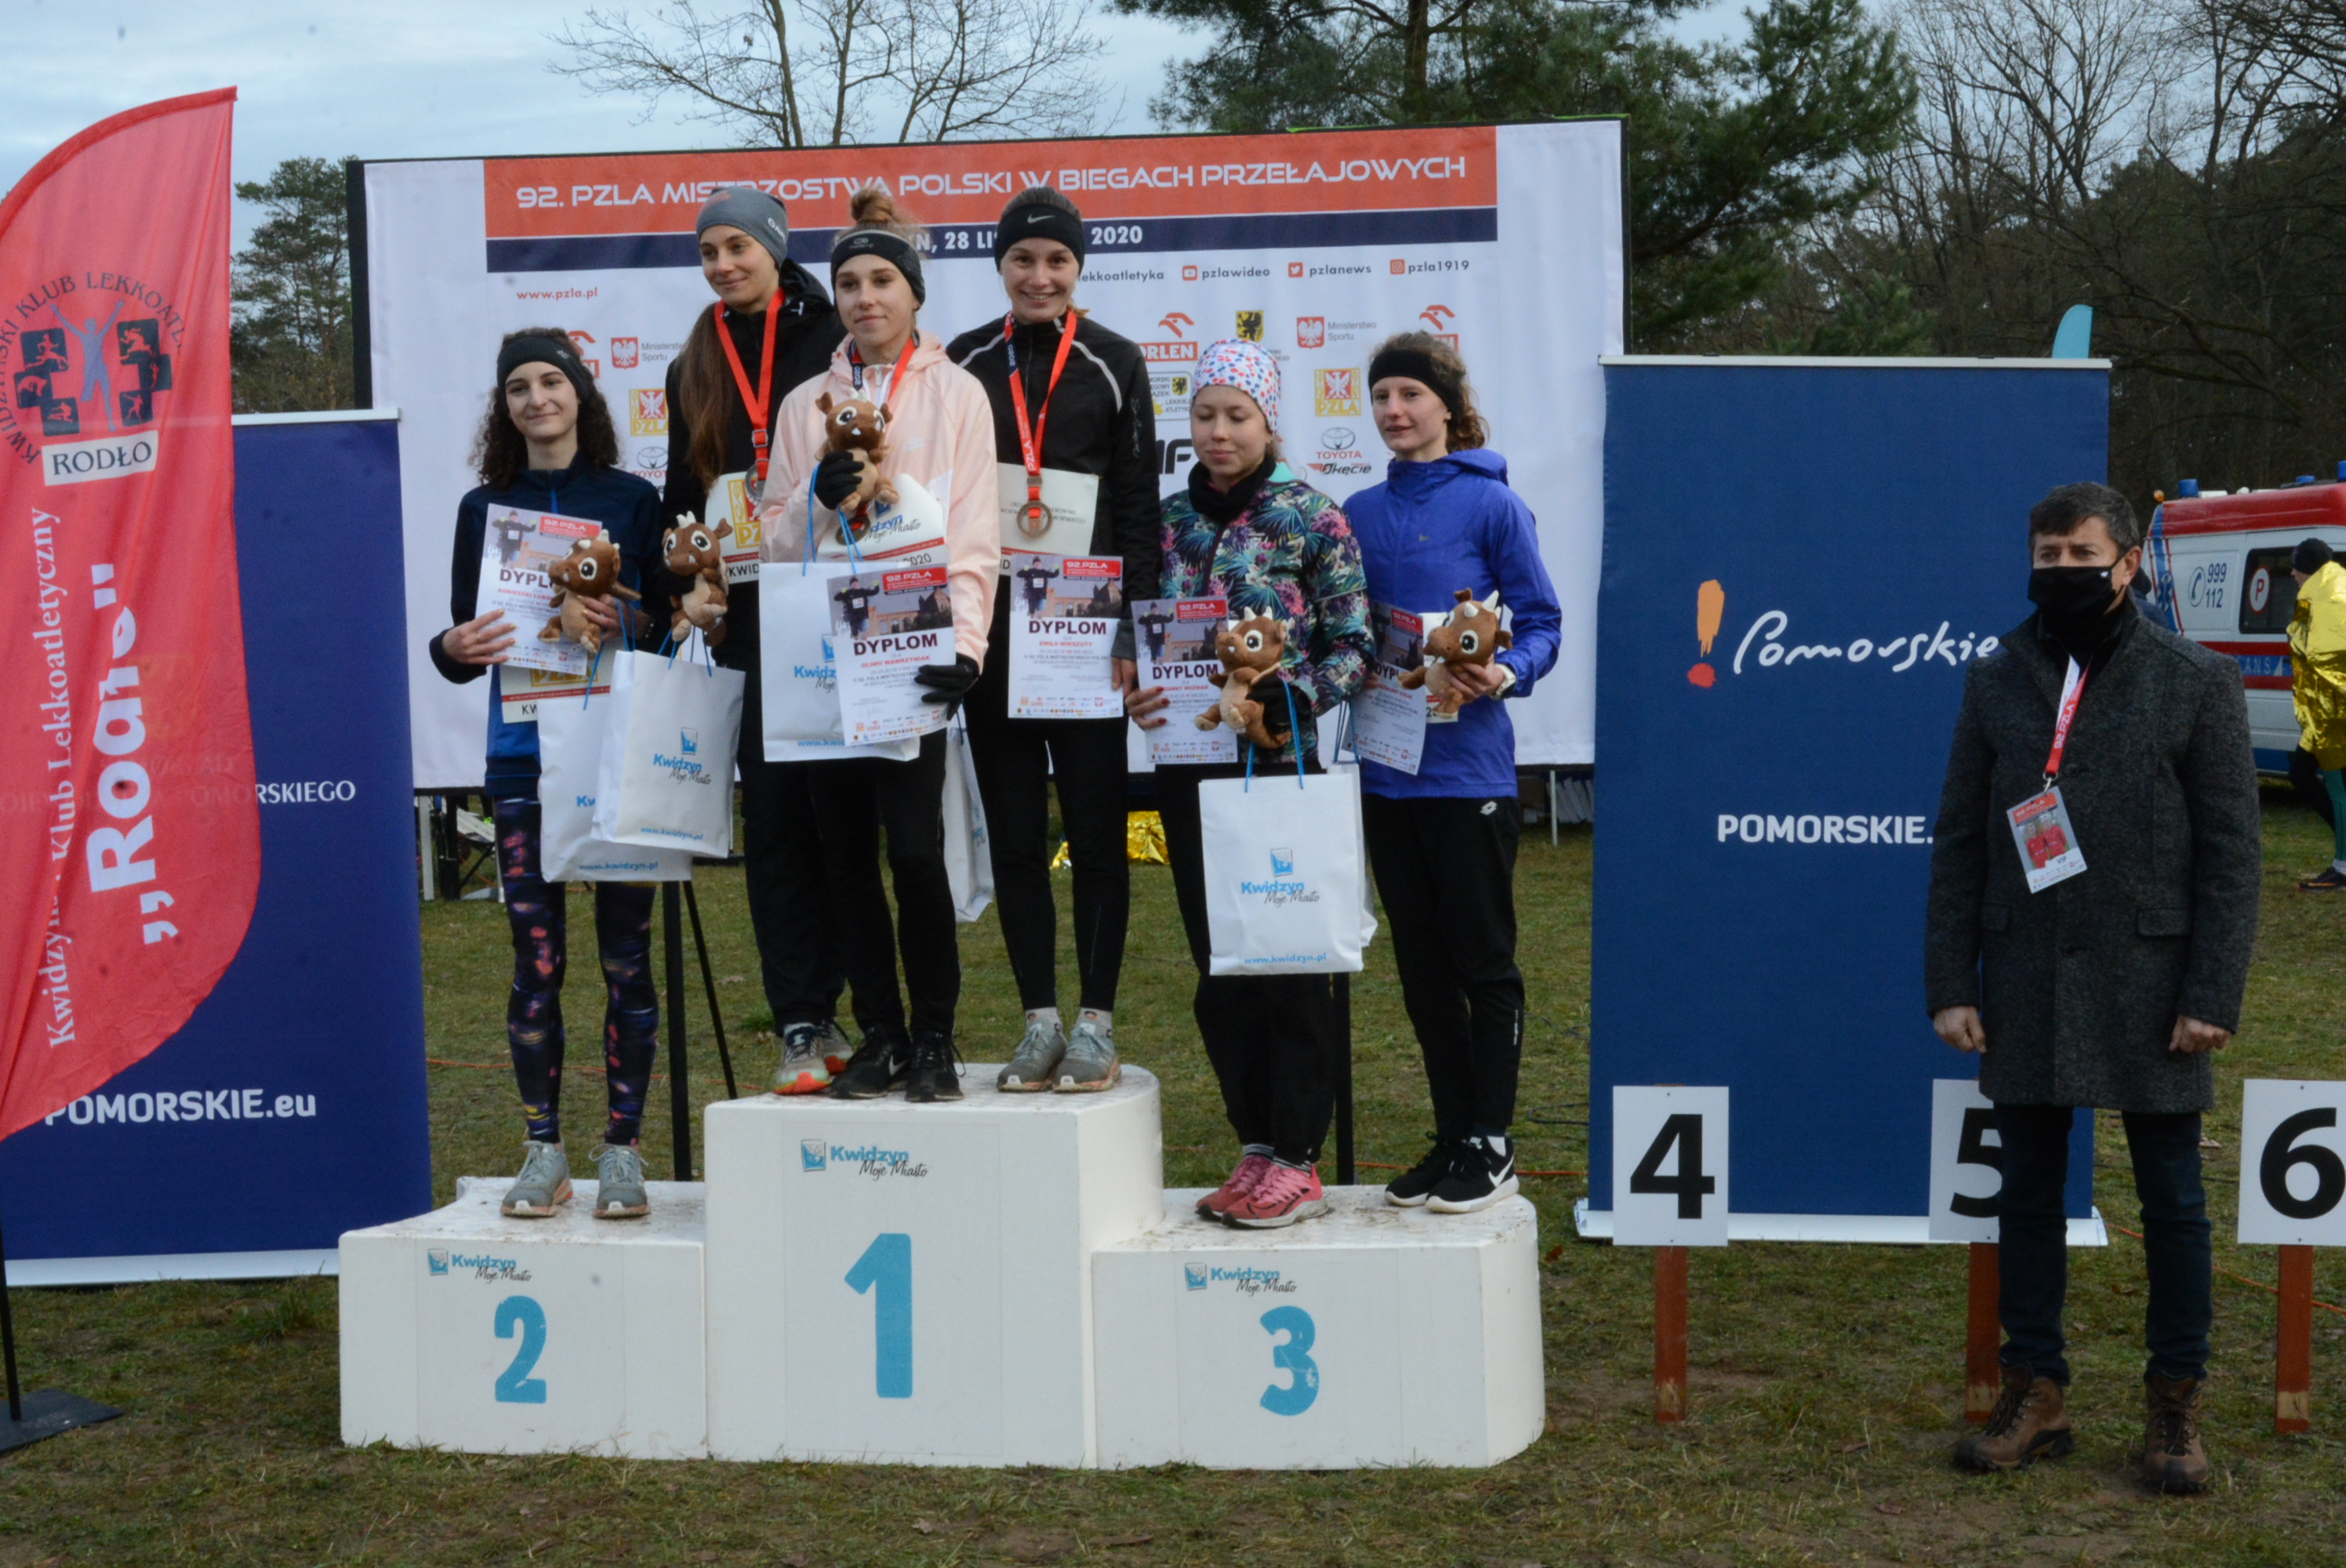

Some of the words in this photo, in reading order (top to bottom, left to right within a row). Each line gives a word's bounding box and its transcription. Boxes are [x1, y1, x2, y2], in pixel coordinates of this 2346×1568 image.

[516, 186, 565, 209] 92.
[572, 183, 656, 207] PZLA
[899, 171, 1012, 197] POLSKI
[1019, 169, 1052, 190] W
[1059, 165, 1193, 191] BIEGACH
[1201, 155, 1466, 187] PRZEŁAJOWYCH
[944, 231, 970, 250] 28
[1090, 225, 1144, 245] 2020
[1201, 265, 1271, 281] pzlawideo
[1309, 263, 1372, 279] pzlanews
[1407, 260, 1470, 275] pzla1919
[16, 274, 77, 319] KLUB
[516, 286, 599, 301] www.pzla.pl
[1327, 320, 1378, 330] Ministerstwo
[1327, 332, 1355, 342] Sportu
[641, 352, 668, 361] Sportu
[1317, 401, 1359, 415] PZLA
[51, 441, 152, 476] RODŁO
[1316, 451, 1362, 459] TOYOTA
[870, 514, 903, 533] dzyn
[499, 568, 553, 589] DYPL
[2207, 562, 2228, 583] 999
[2205, 588, 2224, 608] 112
[2255, 578, 2265, 601] P
[1029, 619, 1107, 635] DYPLOM
[31, 506, 73, 772] Lekkoatletyczny
[853, 633, 938, 656] DYPLOM
[1733, 609, 1999, 674] Pomorskie
[794, 665, 837, 678] Kwidz
[1153, 663, 1219, 680] DYPLOM
[652, 753, 703, 775] Kwidzyn
[1717, 813, 1934, 844] POMORSKIE.
[1240, 879, 1306, 895] Kwidzyn
[1264, 890, 1287, 908] Moje
[1289, 888, 1321, 903] Miasto
[1244, 952, 1327, 964] www.kwidzyn.pl
[830, 1145, 910, 1167] Kwidzyn
[1629, 1113, 1716, 1219] 4
[1949, 1107, 2004, 1218] 5
[2260, 1106, 2346, 1220] 6
[859, 1159, 888, 1181] Moje
[890, 1160, 929, 1178] Miasto
[452, 1254, 517, 1272] Kwidzyn
[475, 1266, 499, 1284] Moje
[500, 1266, 532, 1282] Miasto
[1211, 1267, 1280, 1284] Kwidzyn
[1236, 1278, 1261, 1298] Moje
[1263, 1278, 1298, 1293] Miasto
[844, 1232, 913, 1399] 1
[494, 1295, 547, 1403] 2
[1259, 1305, 1320, 1416] 3
